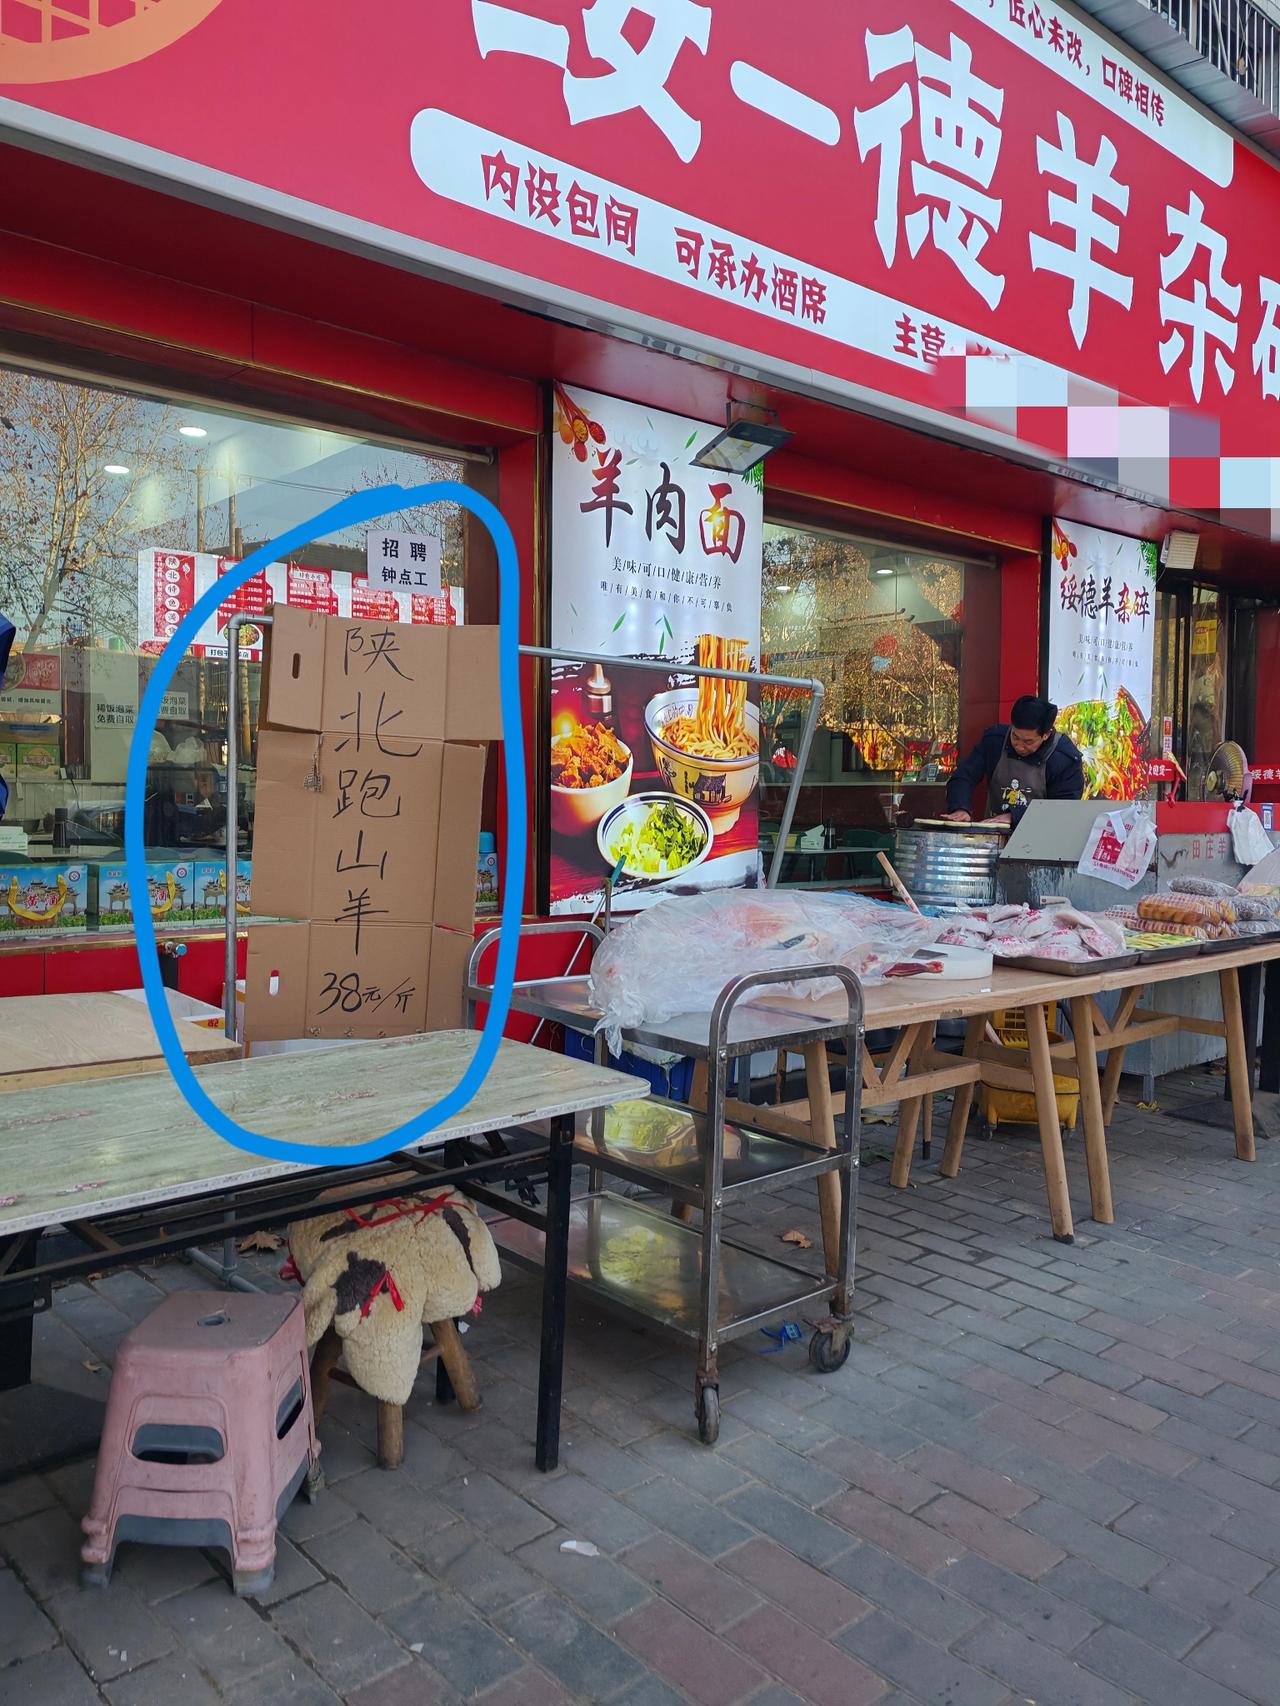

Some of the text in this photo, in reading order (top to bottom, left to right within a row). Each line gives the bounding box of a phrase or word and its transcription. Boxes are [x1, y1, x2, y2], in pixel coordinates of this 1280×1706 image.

[480, 149, 945, 365] 内设包间 可承办酒席 主营
[579, 447, 746, 565] 羊肉面
[382, 537, 427, 562] 招聘
[381, 566, 428, 586] 钟点工
[1060, 573, 1150, 632] 绥德羊杂碎
[96, 703, 134, 714] 稀饭泡菜
[96, 714, 134, 724] 免费自取
[332, 626, 423, 956] 陕北跑山羊
[316, 972, 416, 1015] 38元/斤
